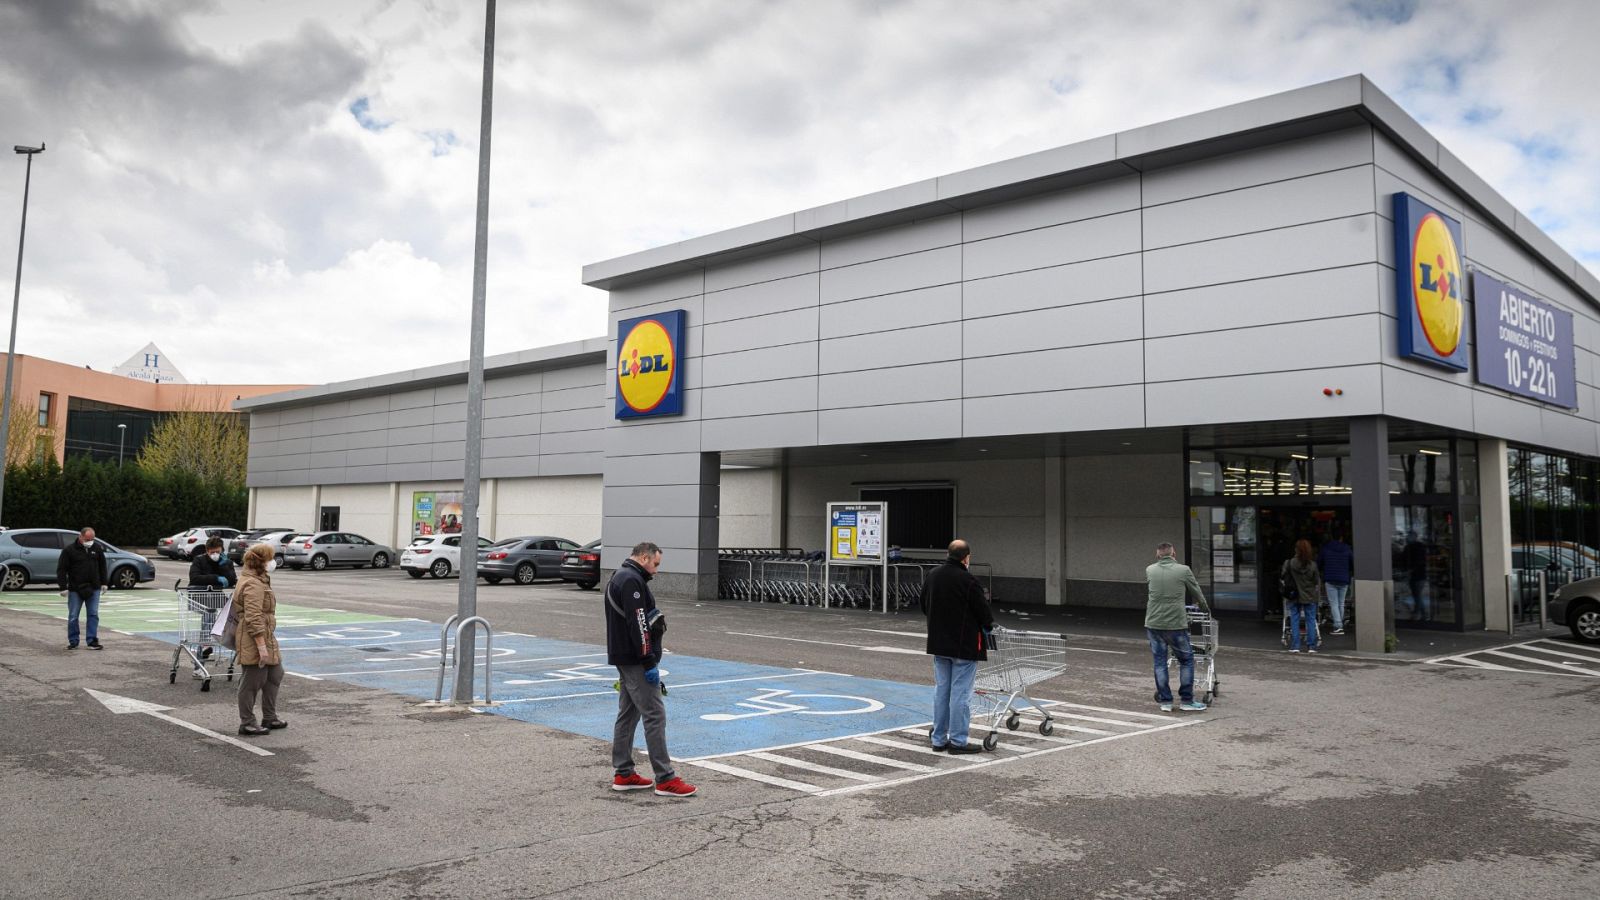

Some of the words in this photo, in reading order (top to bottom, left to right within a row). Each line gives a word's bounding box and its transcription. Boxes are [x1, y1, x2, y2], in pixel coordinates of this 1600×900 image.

[1500, 290, 1555, 342] ABIERTO
[1499, 325, 1530, 350] DOMINGOS
[1533, 339, 1558, 360] FESTIVOS
[620, 349, 669, 379] LIDL
